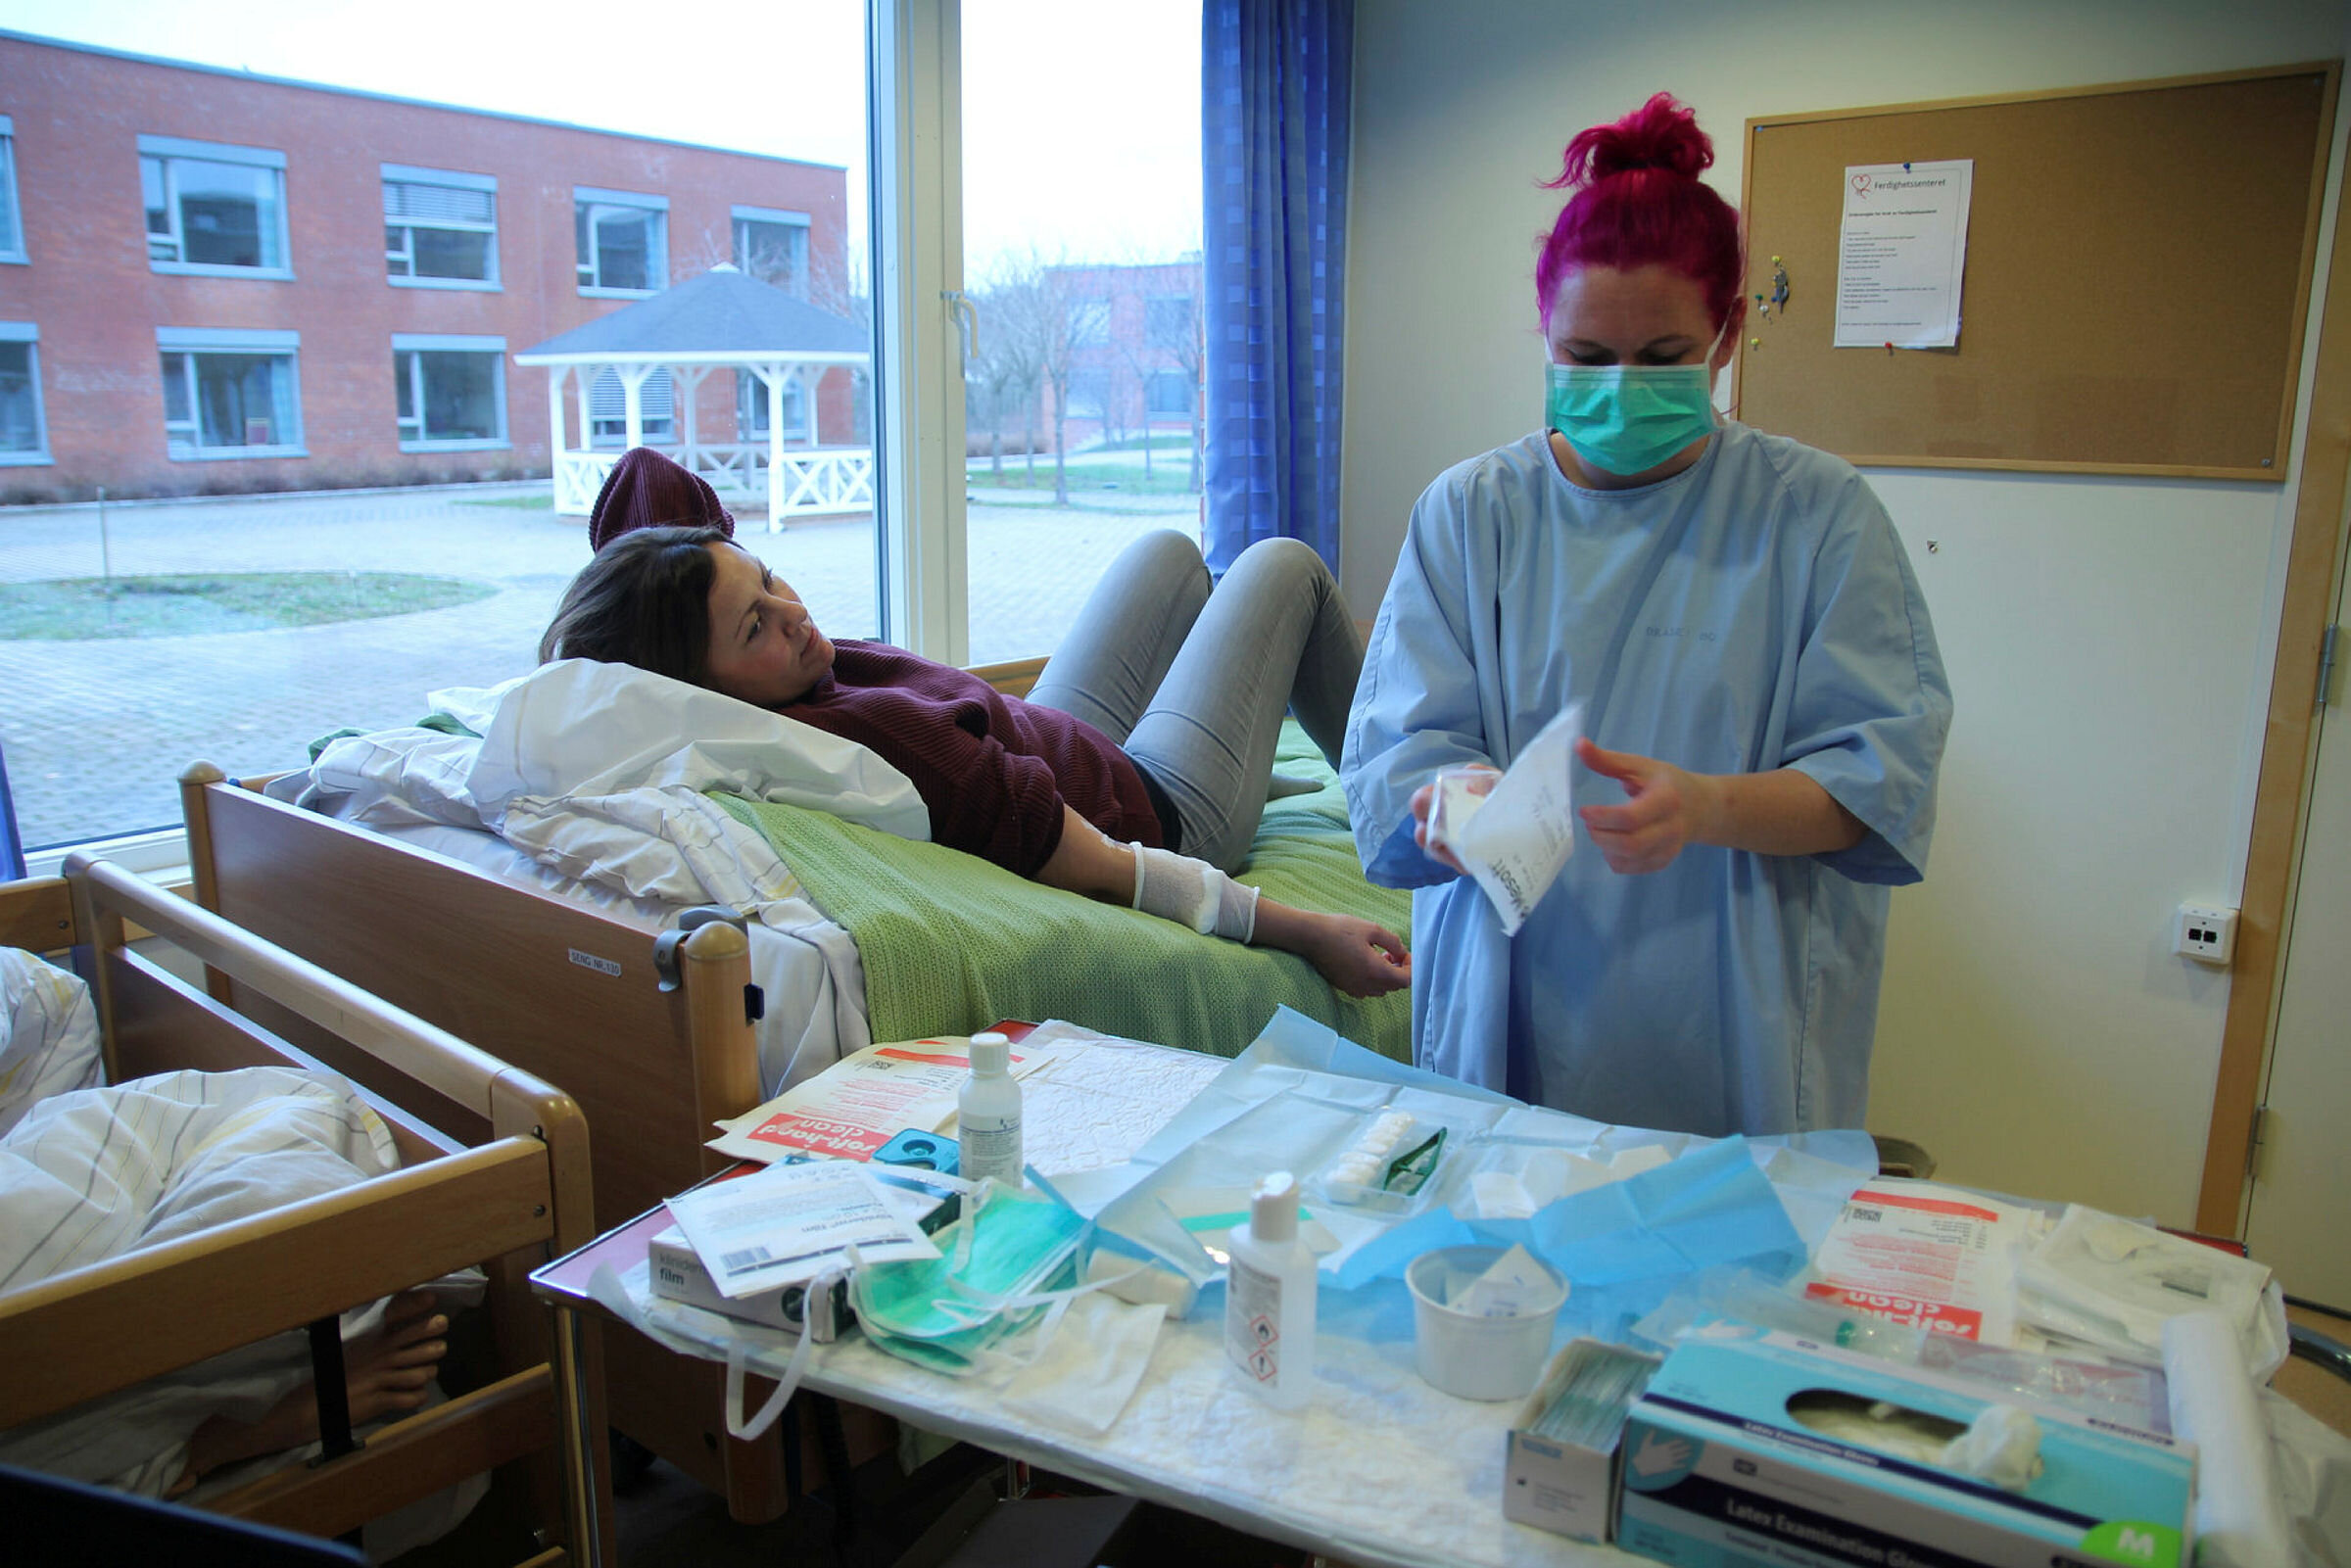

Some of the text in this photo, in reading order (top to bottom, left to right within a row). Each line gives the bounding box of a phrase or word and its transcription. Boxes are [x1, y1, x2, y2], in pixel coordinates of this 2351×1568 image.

[757, 1123, 877, 1152] soft-hand
[798, 1118, 865, 1137] clean
[659, 1266, 685, 1285] film
[1847, 1290, 1942, 1315] clean
[1744, 1420, 1773, 1439] Latex
[1726, 1497, 1772, 1527] Latex
[1775, 1515, 1885, 1562] Examination
[2118, 1527, 2155, 1560] M
